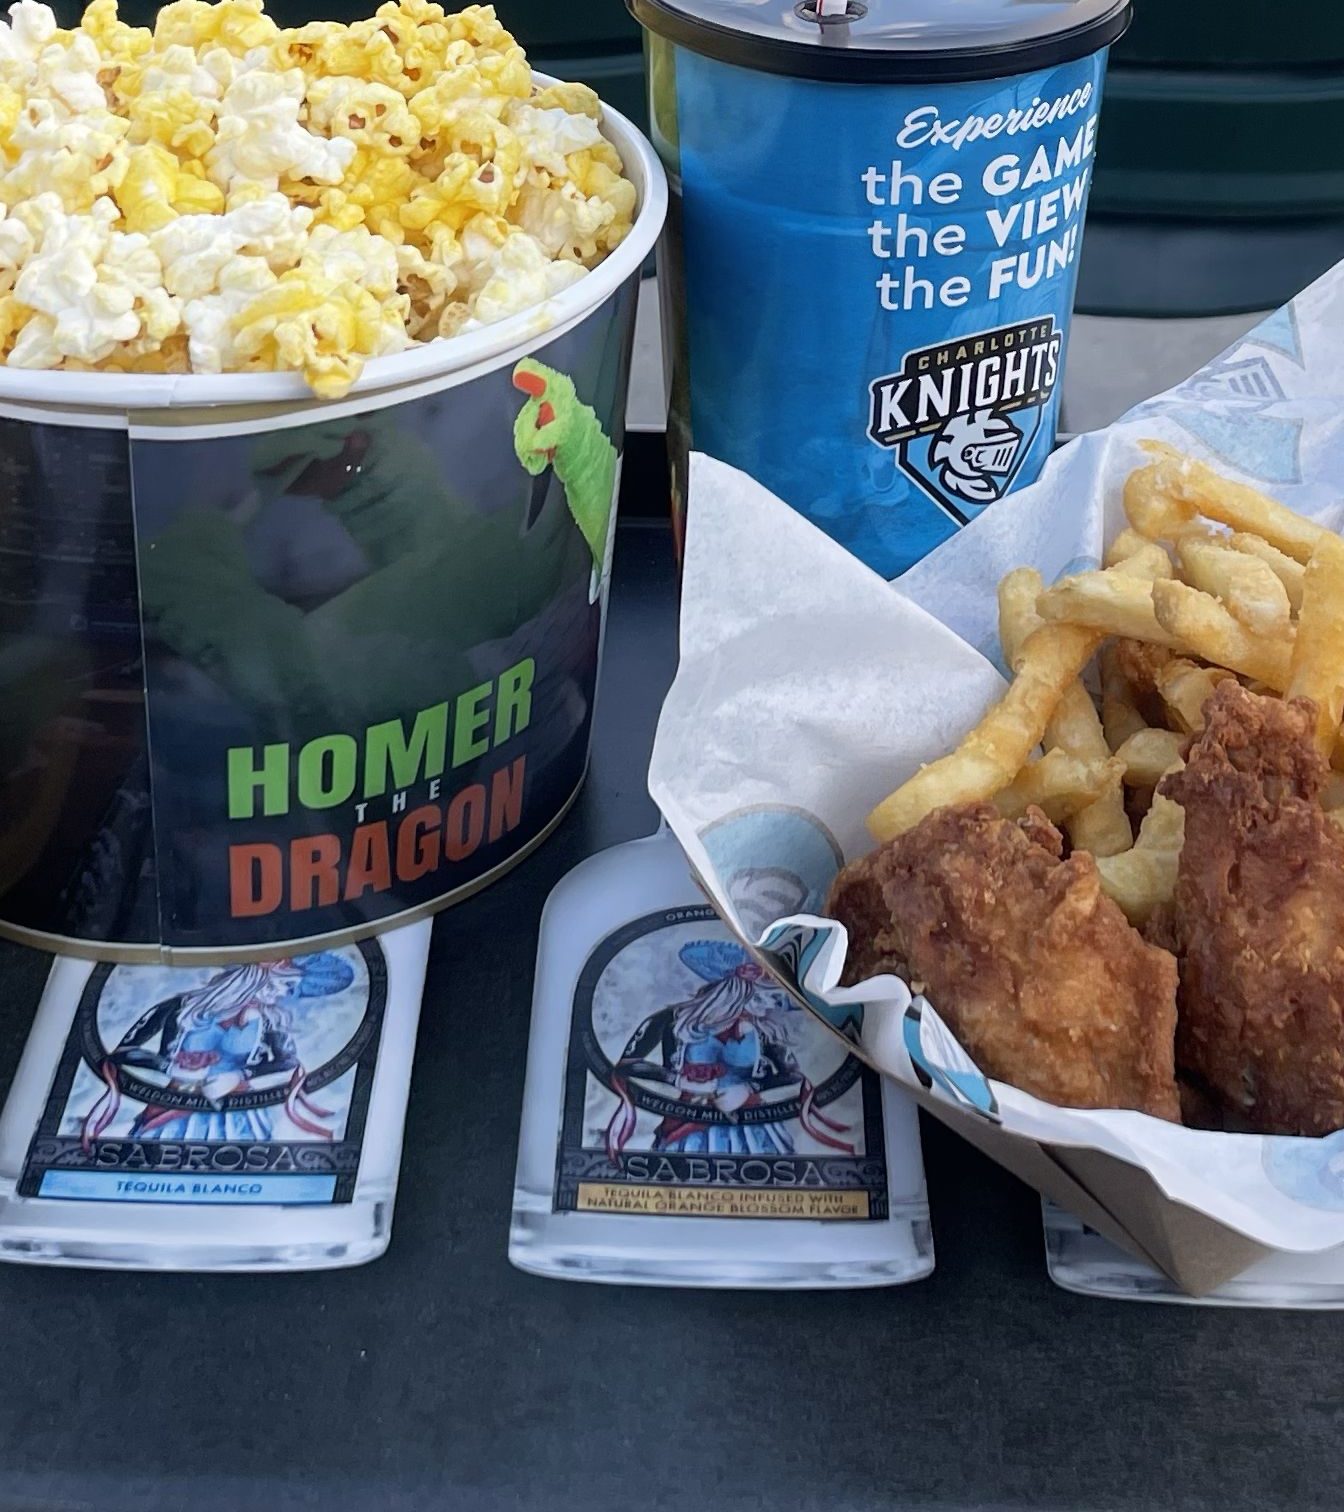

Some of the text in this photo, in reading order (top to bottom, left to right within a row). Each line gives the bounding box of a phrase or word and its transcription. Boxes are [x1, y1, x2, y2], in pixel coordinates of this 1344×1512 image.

[896, 82, 1092, 151] Experience
[861, 113, 1098, 205] the GAME
[868, 168, 1089, 258] the VIEW
[875, 224, 1078, 310] the FUN!
[918, 325, 1047, 369] CHARLOTTE
[877, 340, 1060, 433] KNIGHTS
[227, 657, 536, 819] HOMER
[355, 779, 441, 823] THE
[229, 754, 527, 918] DRAGON
[666, 908, 716, 921] ORANG
[128, 1082, 182, 1105] WELDON
[641, 1094, 697, 1120] WELDON
[96, 1143, 297, 1171] SABROSA
[626, 1156, 825, 1186] SABROSA
[116, 1180, 263, 1194] TEQUILA BLANCO
[587, 1197, 858, 1216] NATURAL ORANGE BLOSSOM FLAVOR
[606, 1188, 843, 1205] TEQUILA BLANCO INFUSED WITH
